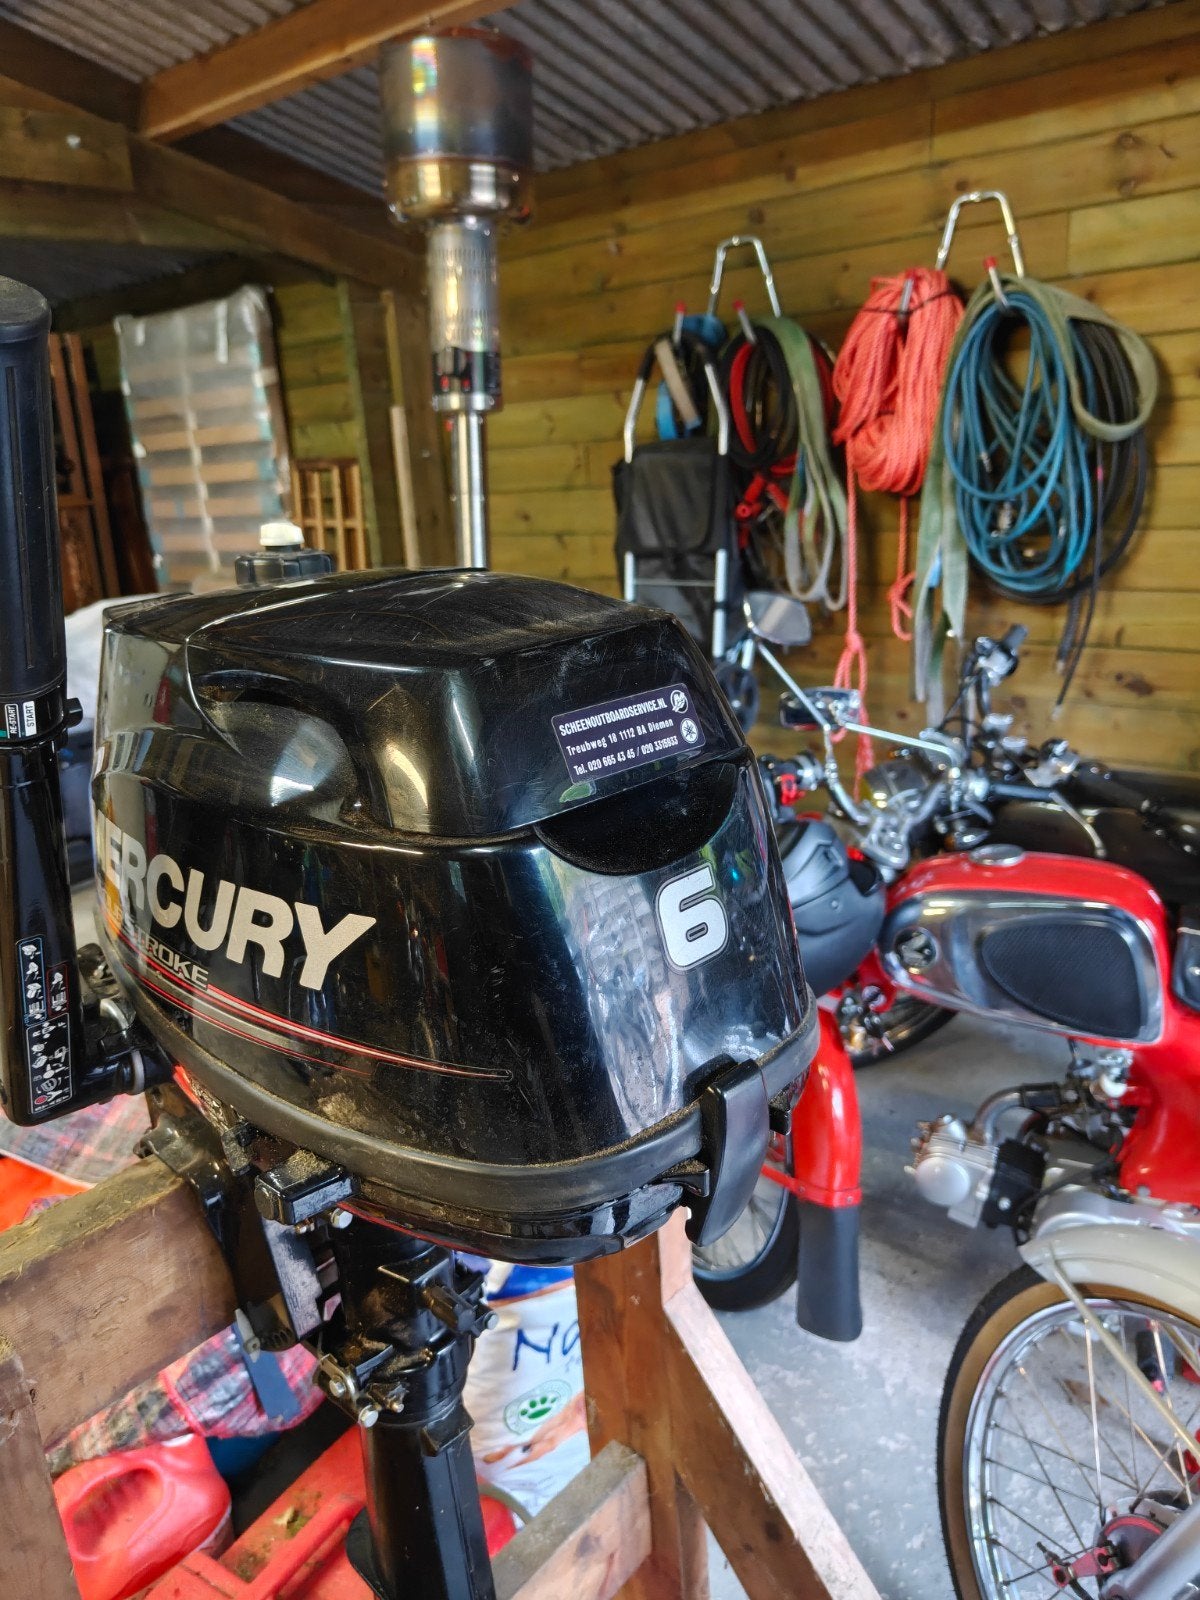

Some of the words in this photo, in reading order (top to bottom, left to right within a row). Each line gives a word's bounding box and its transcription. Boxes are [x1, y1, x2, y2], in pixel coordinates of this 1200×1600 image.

[25, 705, 35, 728] START
[558, 697, 668, 736] SCHEENOUTBOARDSERVICE.NL
[566, 736, 608, 756] Treubweg
[608, 732, 618, 744] 18
[618, 727, 636, 741] 1112
[636, 724, 648, 736] BA
[648, 718, 674, 733] Diemen
[573, 764, 588, 776] Tel.
[587, 758, 603, 772] 020
[602, 754, 617, 767] 665
[617, 751, 626, 763] 43
[626, 748, 636, 759] 45
[640, 743, 654, 755] 020
[655, 862, 729, 971] 6
